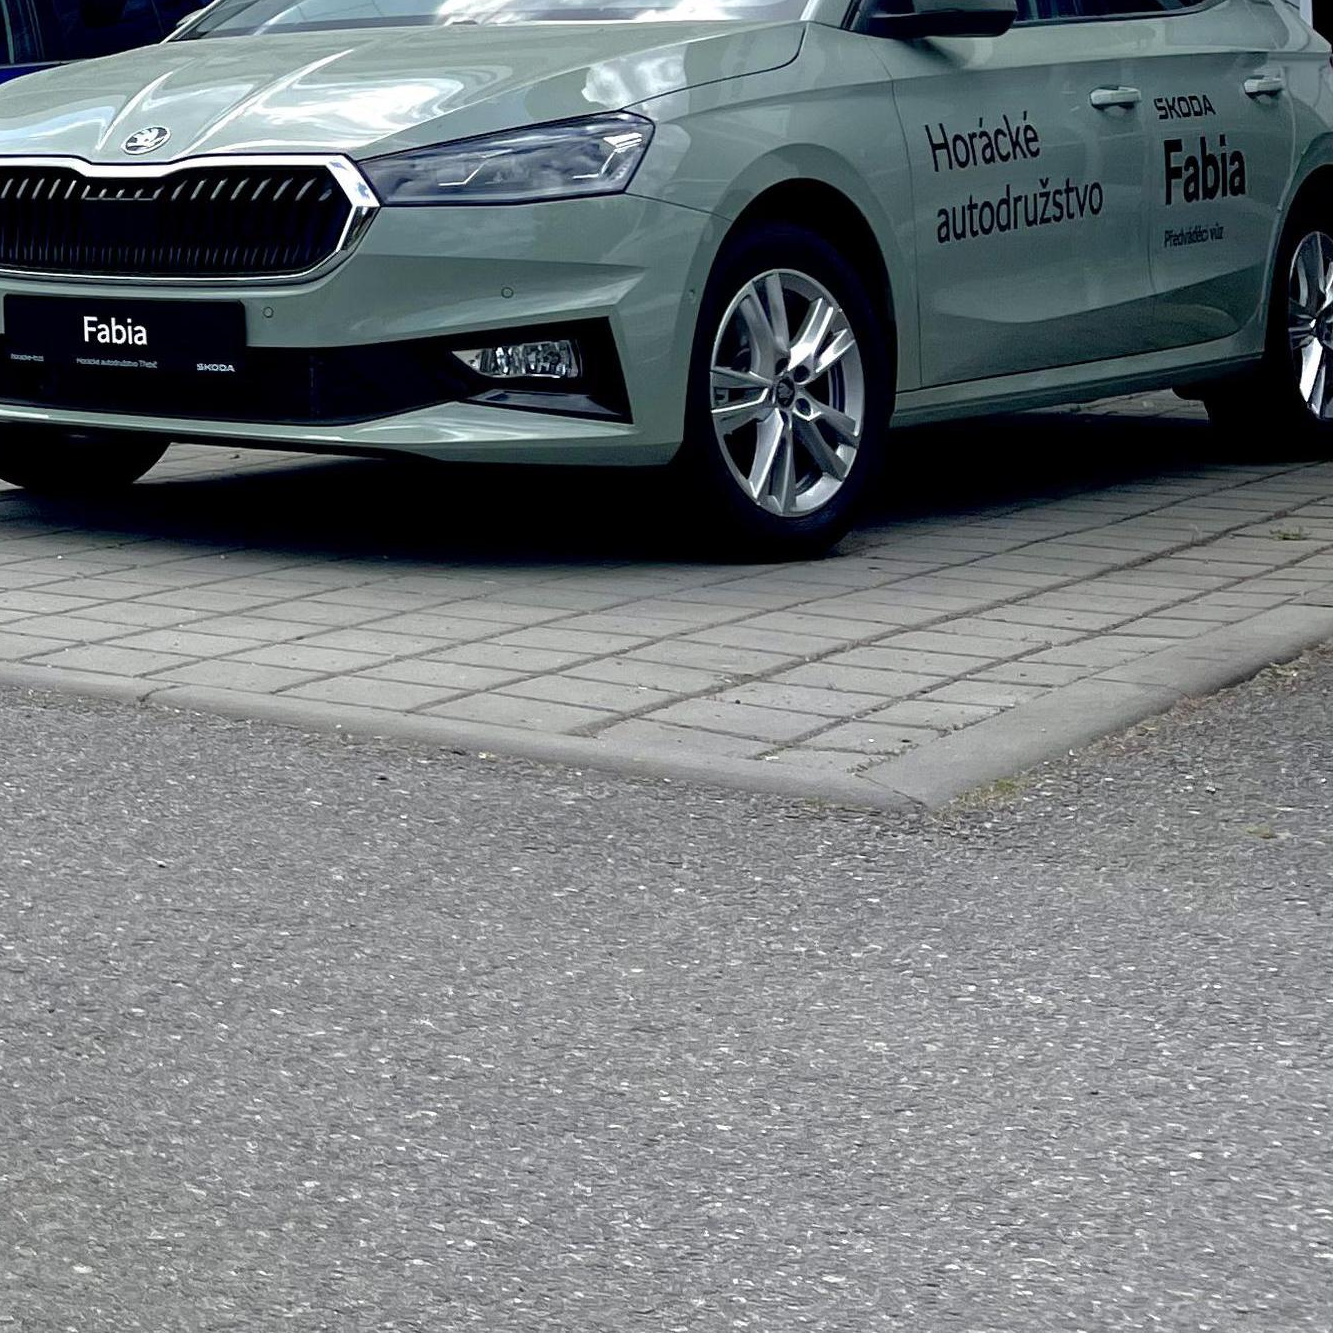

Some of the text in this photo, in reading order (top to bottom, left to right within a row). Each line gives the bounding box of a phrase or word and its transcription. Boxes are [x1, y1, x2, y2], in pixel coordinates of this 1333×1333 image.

[925, 110, 1041, 172] Horácké
[1163, 134, 1247, 205] Fabia
[937, 177, 1103, 244] autodružstvo
[83, 316, 148, 346] Fabia
